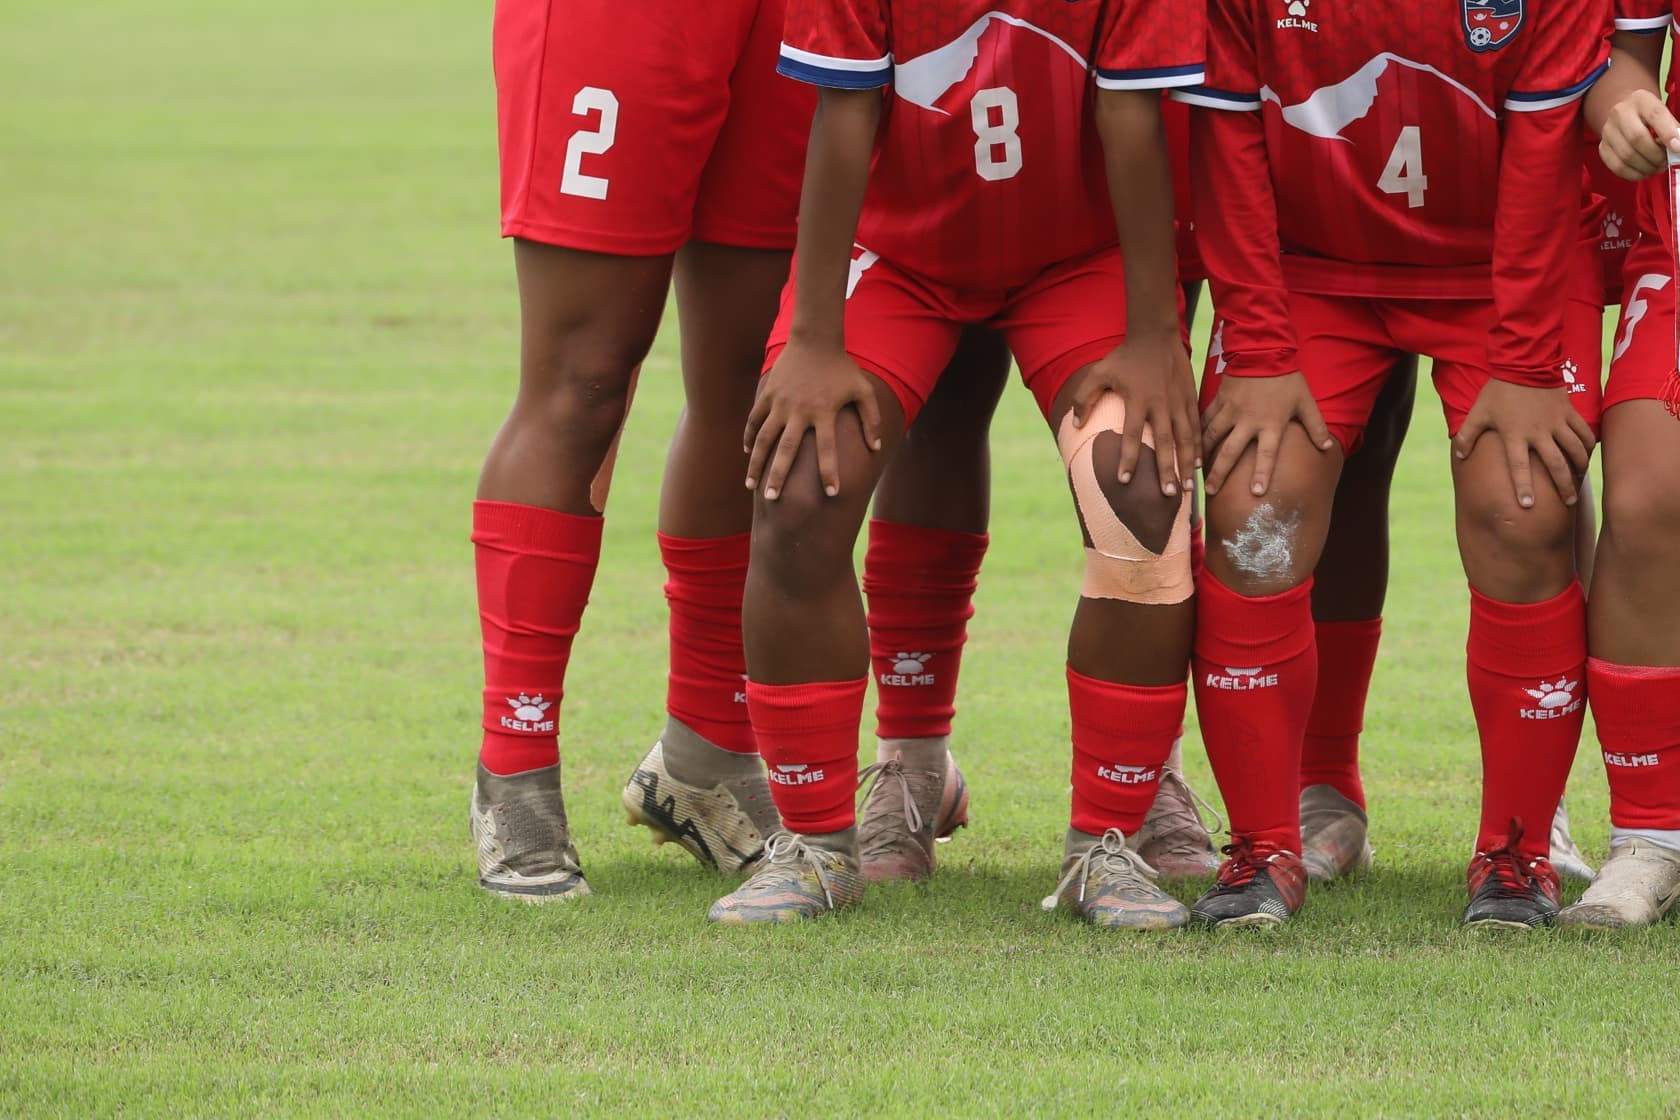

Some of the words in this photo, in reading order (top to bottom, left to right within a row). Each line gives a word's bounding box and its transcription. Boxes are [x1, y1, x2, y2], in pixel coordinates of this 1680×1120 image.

[1277, 18, 1318, 33] KELME
[971, 86, 1023, 181] 8
[560, 86, 619, 200] 2
[1377, 126, 1428, 208] 4
[1601, 238, 1632, 250] ELME
[880, 674, 935, 686] KELME
[1206, 672, 1278, 690] KELME
[501, 716, 554, 732] KELME
[1603, 752, 1659, 768] KELME
[767, 768, 824, 785] KELME
[1097, 766, 1156, 784] KELME
